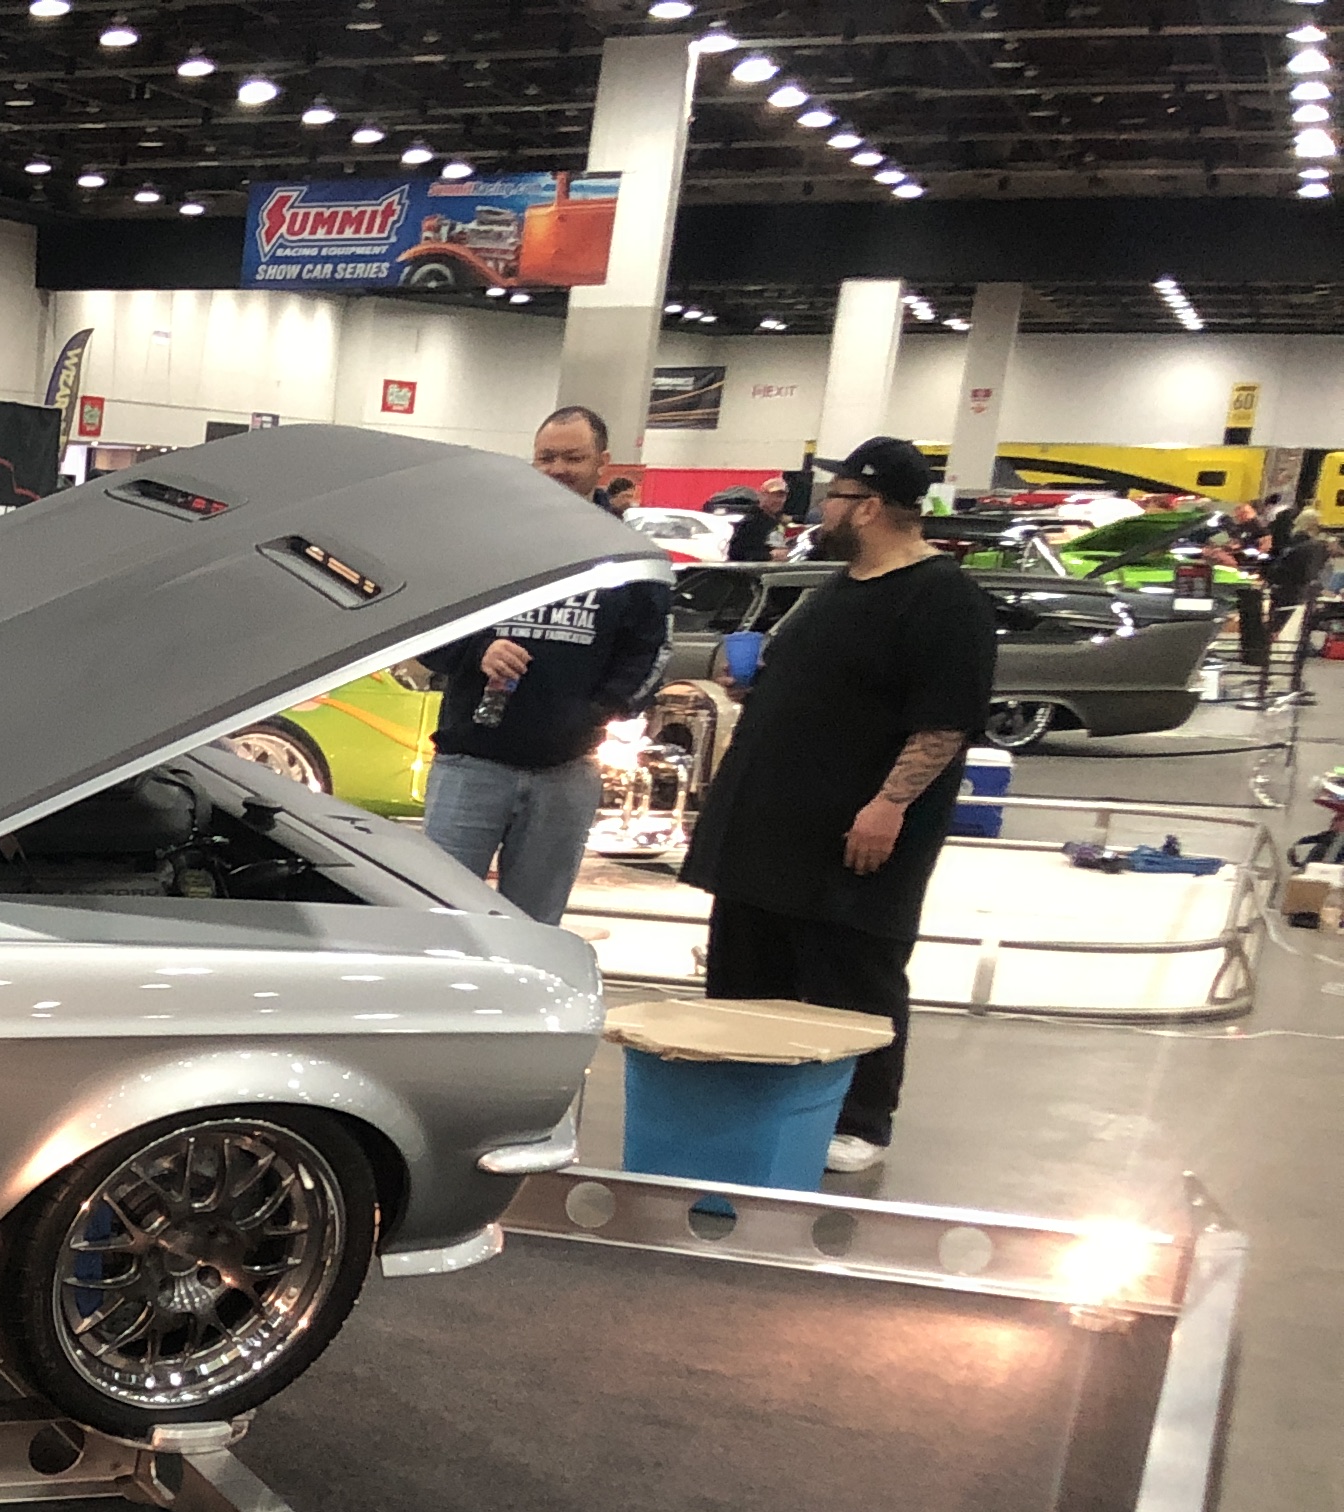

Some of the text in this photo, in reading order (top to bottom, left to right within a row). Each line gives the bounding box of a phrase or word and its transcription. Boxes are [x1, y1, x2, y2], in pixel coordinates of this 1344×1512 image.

[275, 247, 319, 257] RACING
[255, 262, 390, 280] SHOW CAR SERIES
[550, 607, 595, 628] METAL
